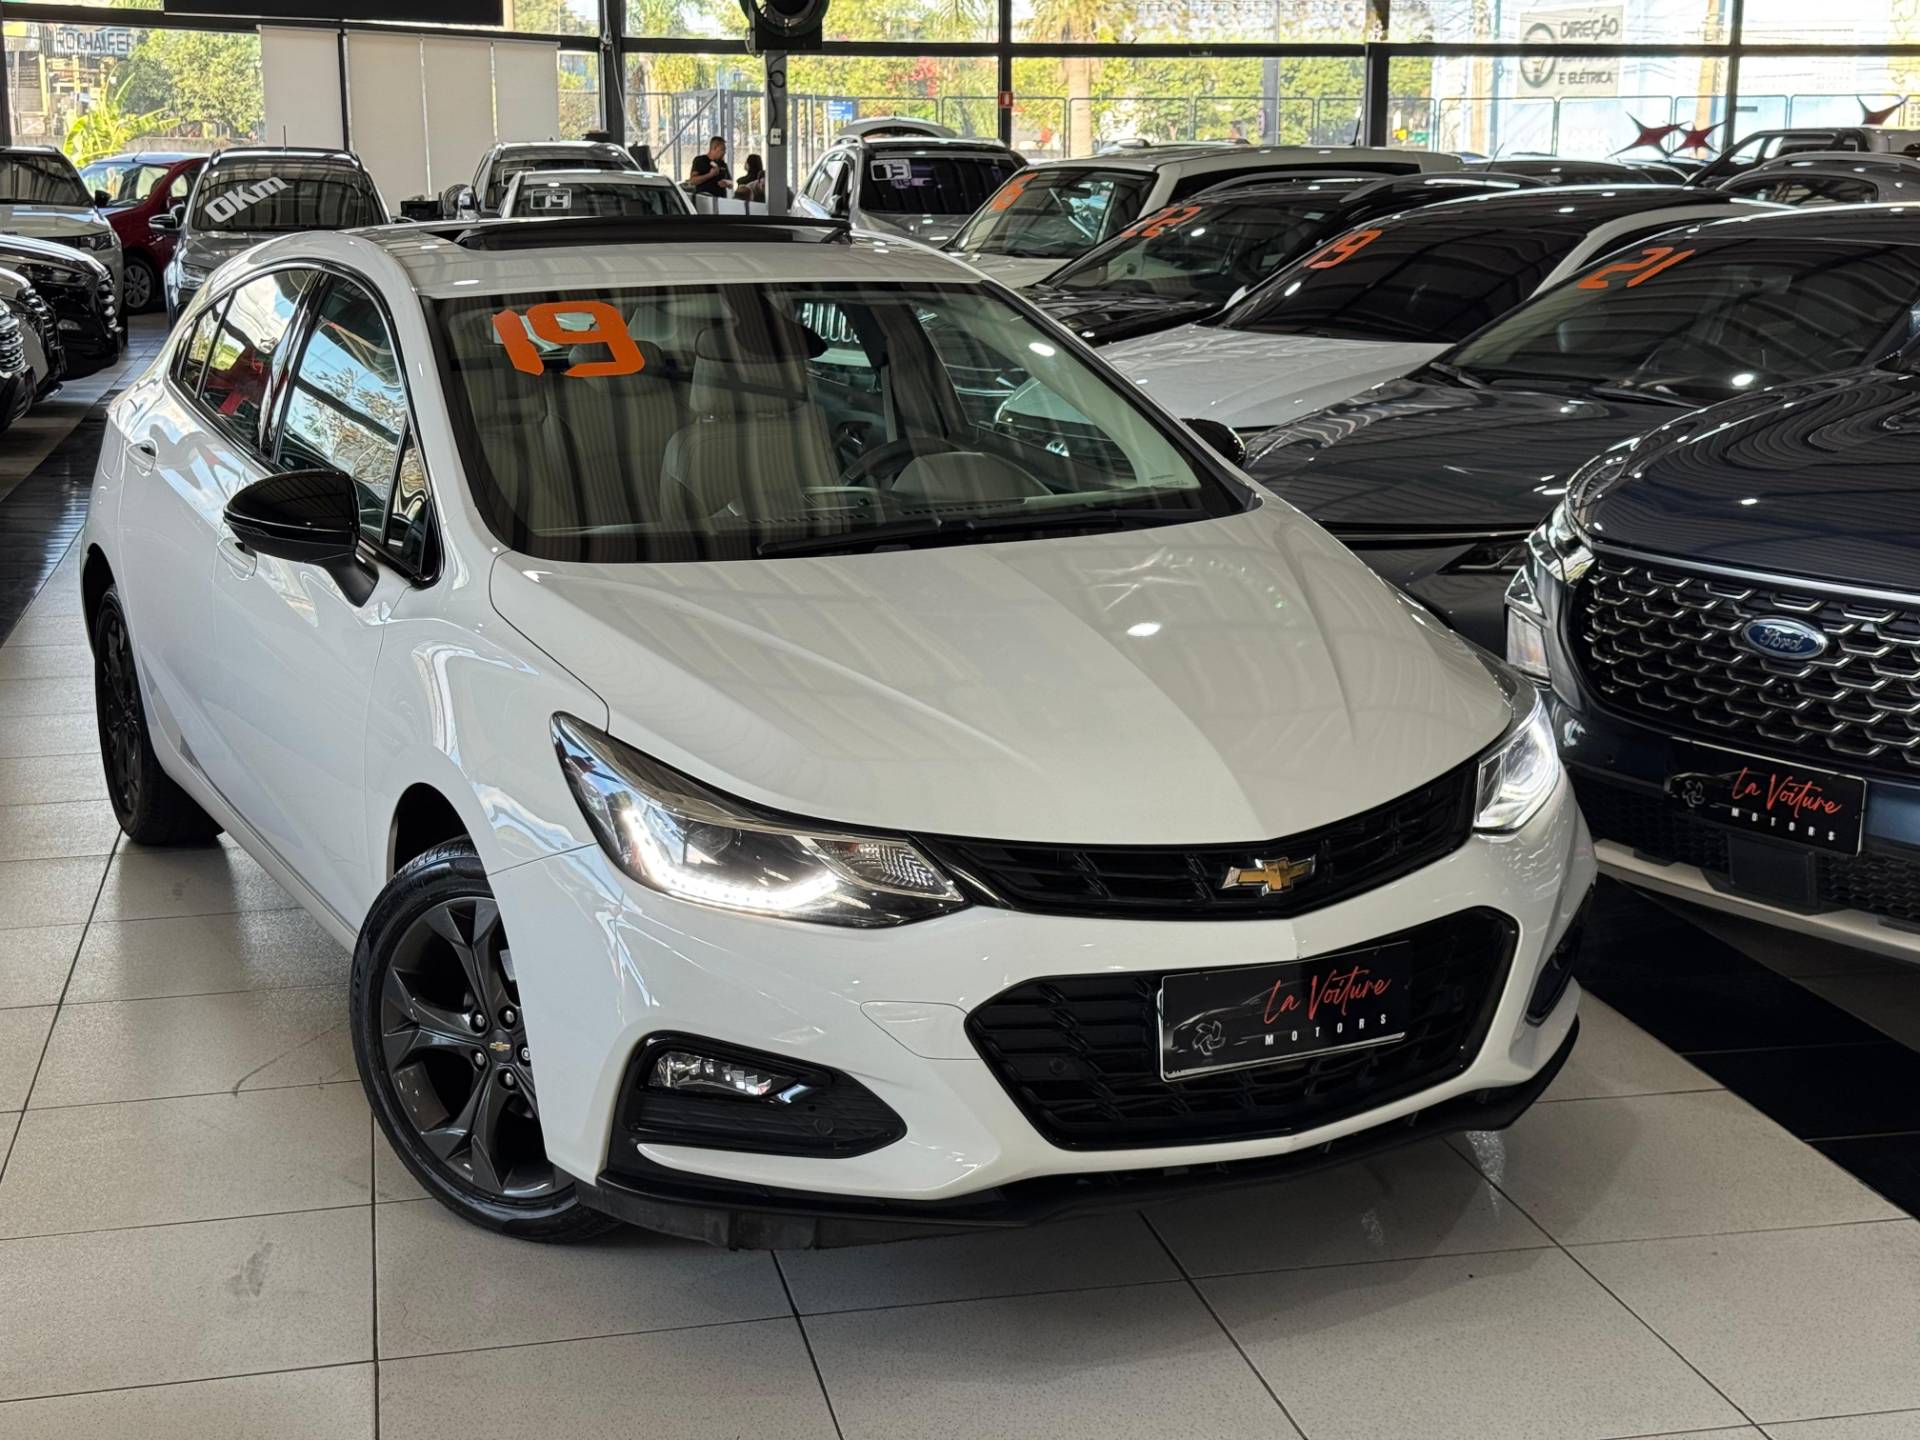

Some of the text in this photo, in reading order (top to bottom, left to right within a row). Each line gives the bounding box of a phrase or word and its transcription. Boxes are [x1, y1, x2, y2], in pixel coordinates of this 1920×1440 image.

[1577, 247, 1696, 288] 21
[492, 301, 645, 377] 19
[1760, 627, 1806, 651] Ford
[1732, 767, 1842, 818] La Voiture
[1731, 808, 1836, 841] MOTORS
[1263, 966, 1391, 1024] La Voiture
[1265, 1014, 1386, 1046] MOTORS
